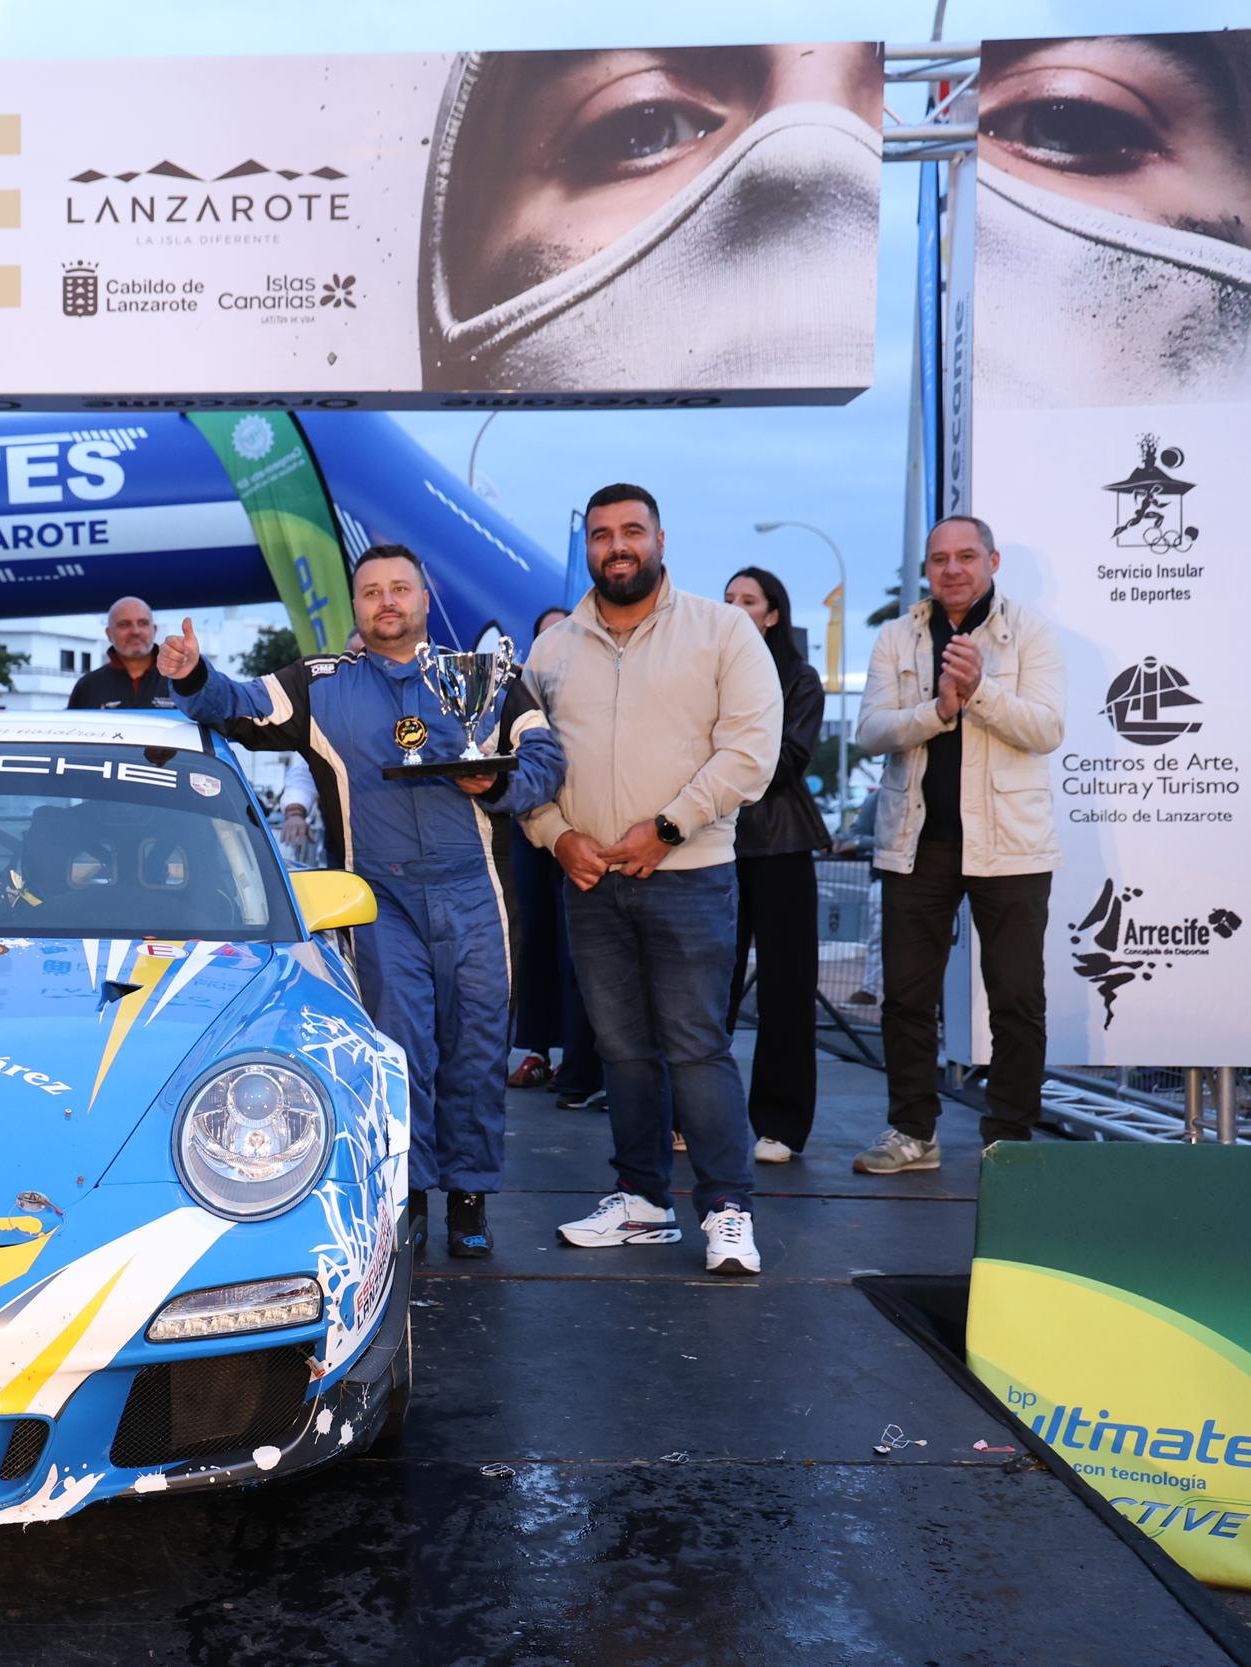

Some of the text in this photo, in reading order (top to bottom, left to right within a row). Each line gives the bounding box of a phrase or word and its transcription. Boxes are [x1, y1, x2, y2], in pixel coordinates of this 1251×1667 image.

[66, 194, 350, 224] LANZAROTE
[136, 234, 281, 245] LA ISLA DIFERENTE
[106, 279, 204, 294] Cabildo de
[266, 275, 316, 292] Islas
[106, 297, 198, 312] Lanzarote
[218, 292, 316, 310] Canarias
[1097, 564, 1205, 581] Servicio Insular
[1110, 587, 1191, 604] de Deportes
[1062, 753, 1239, 773] Centros de Arte,
[1062, 776, 1239, 800] Cultura y Turismo
[1070, 809, 1232, 822] Cabildo de Lanzarote
[1124, 918, 1210, 946] Arrecife
[1007, 1385, 1037, 1409] bp
[1073, 1461, 1207, 1491] con tecnología
[1107, 1496, 1250, 1539] CTIVE
